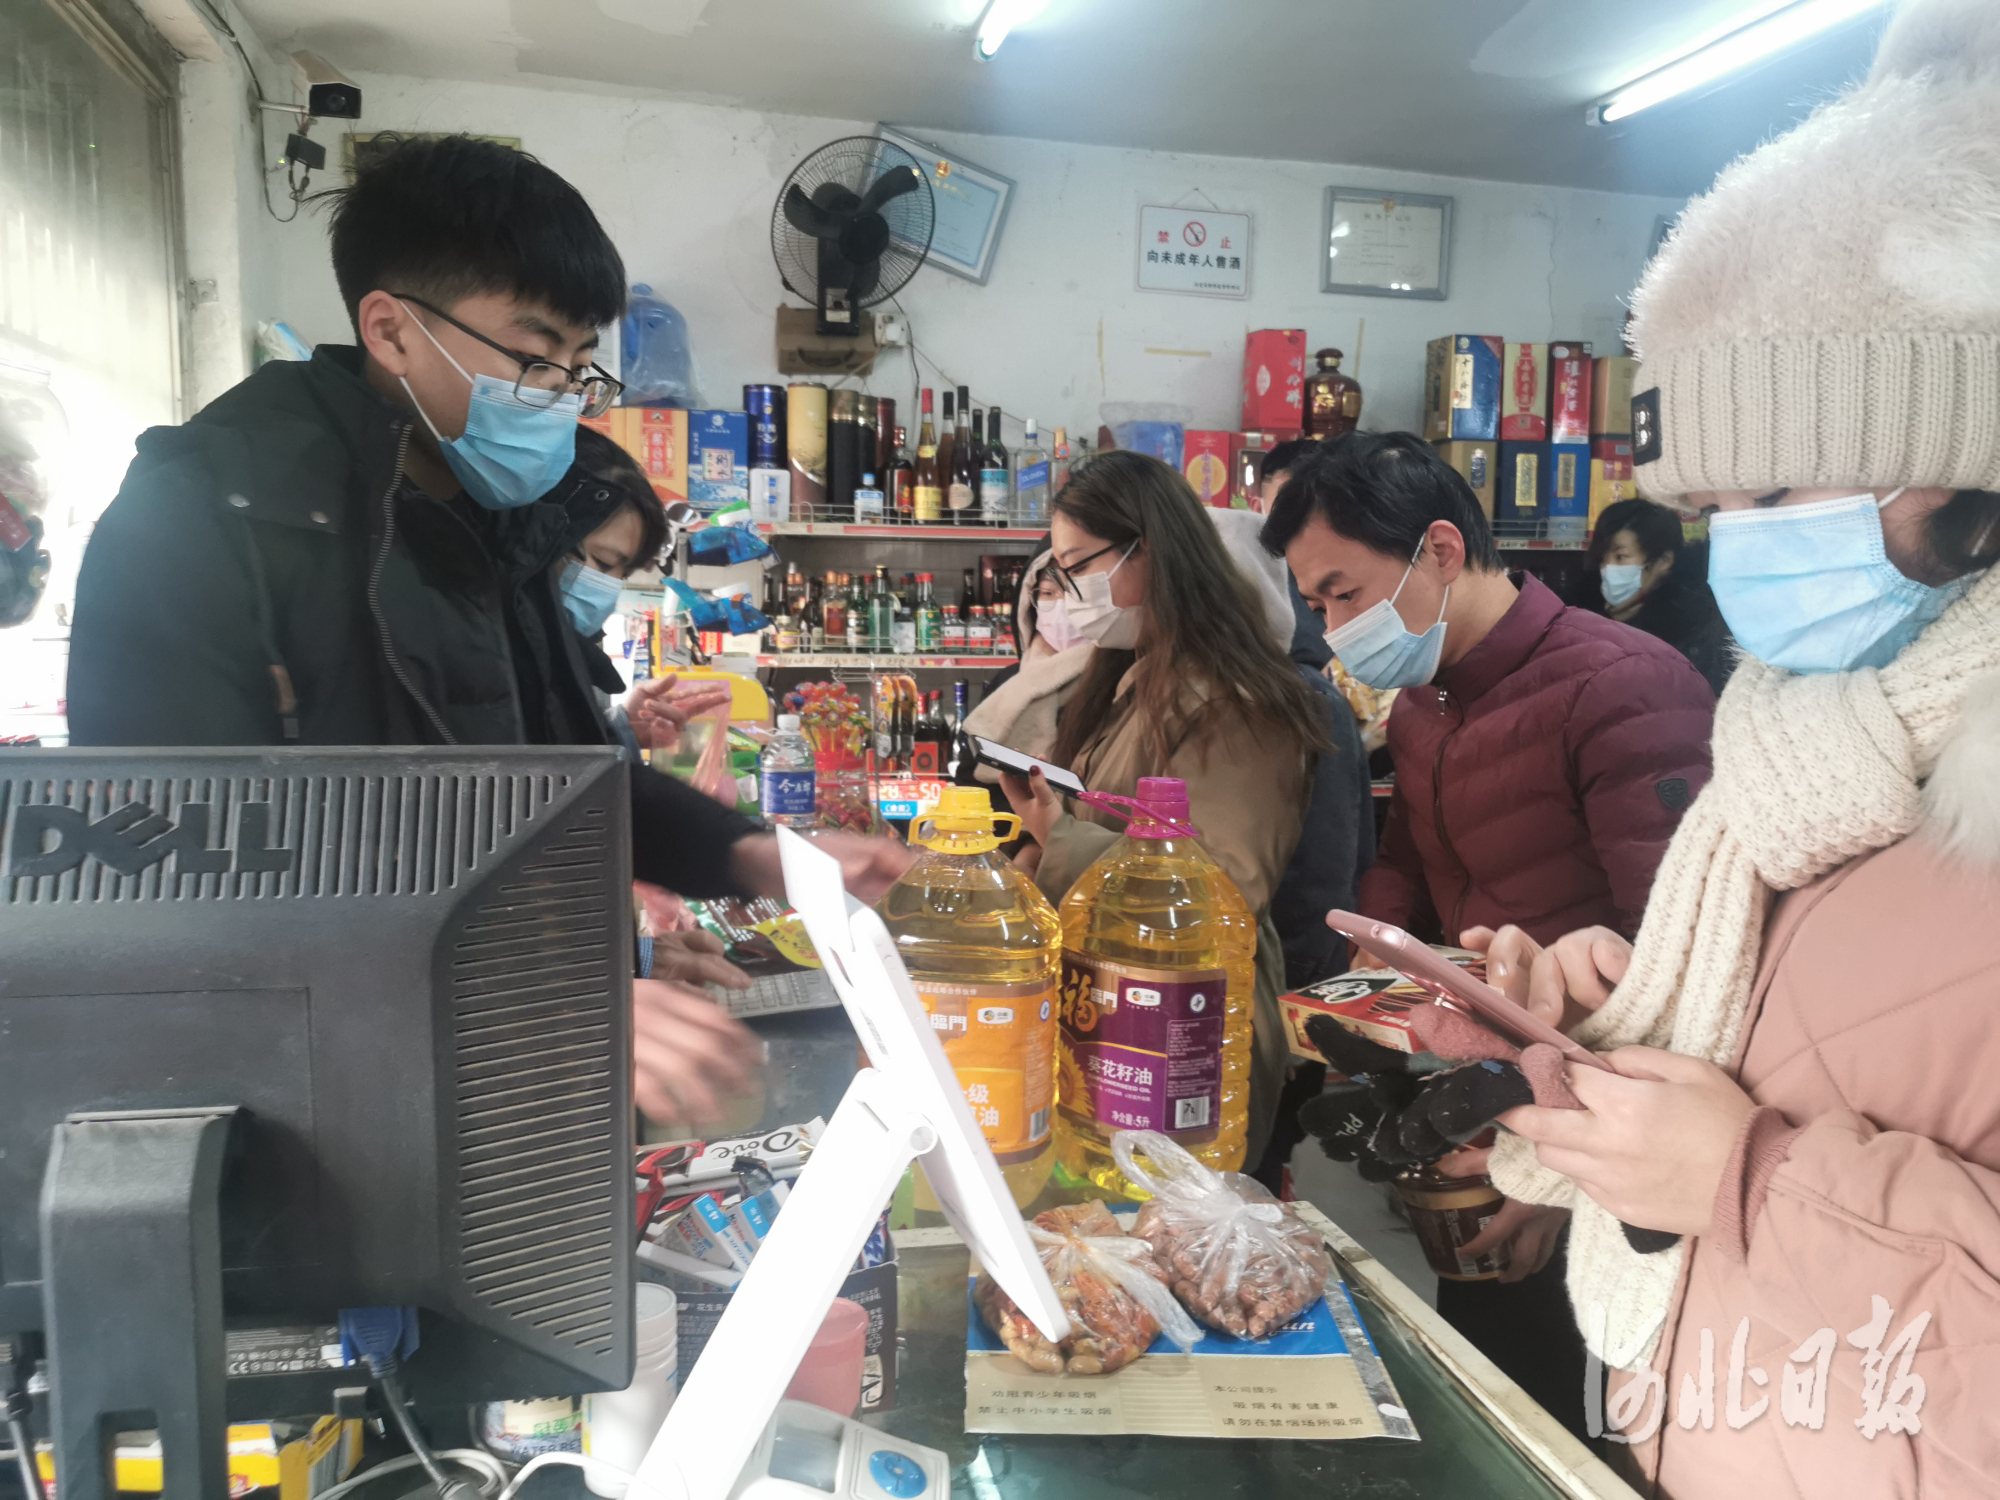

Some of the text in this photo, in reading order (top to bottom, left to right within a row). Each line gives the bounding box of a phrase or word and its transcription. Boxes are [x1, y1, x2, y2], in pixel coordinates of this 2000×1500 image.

[1220, 236, 1232, 249] 止
[1147, 250, 1241, 270] 向未成年人售酒
[6, 800, 292, 878] DELL
[1088, 1055, 1153, 1086] 葵花籽油
[710, 1131, 800, 1158] Dove
[991, 1390, 1097, 1399] 劝阻青少年吸烟
[1214, 1385, 1278, 1394] 本公司提示
[978, 1406, 1112, 1416] 禁止中小学生吸烟
[1232, 1401, 1339, 1411] 吸烟有害健康
[1222, 1417, 1364, 1428] 请勿在禁烟场所吸烟
